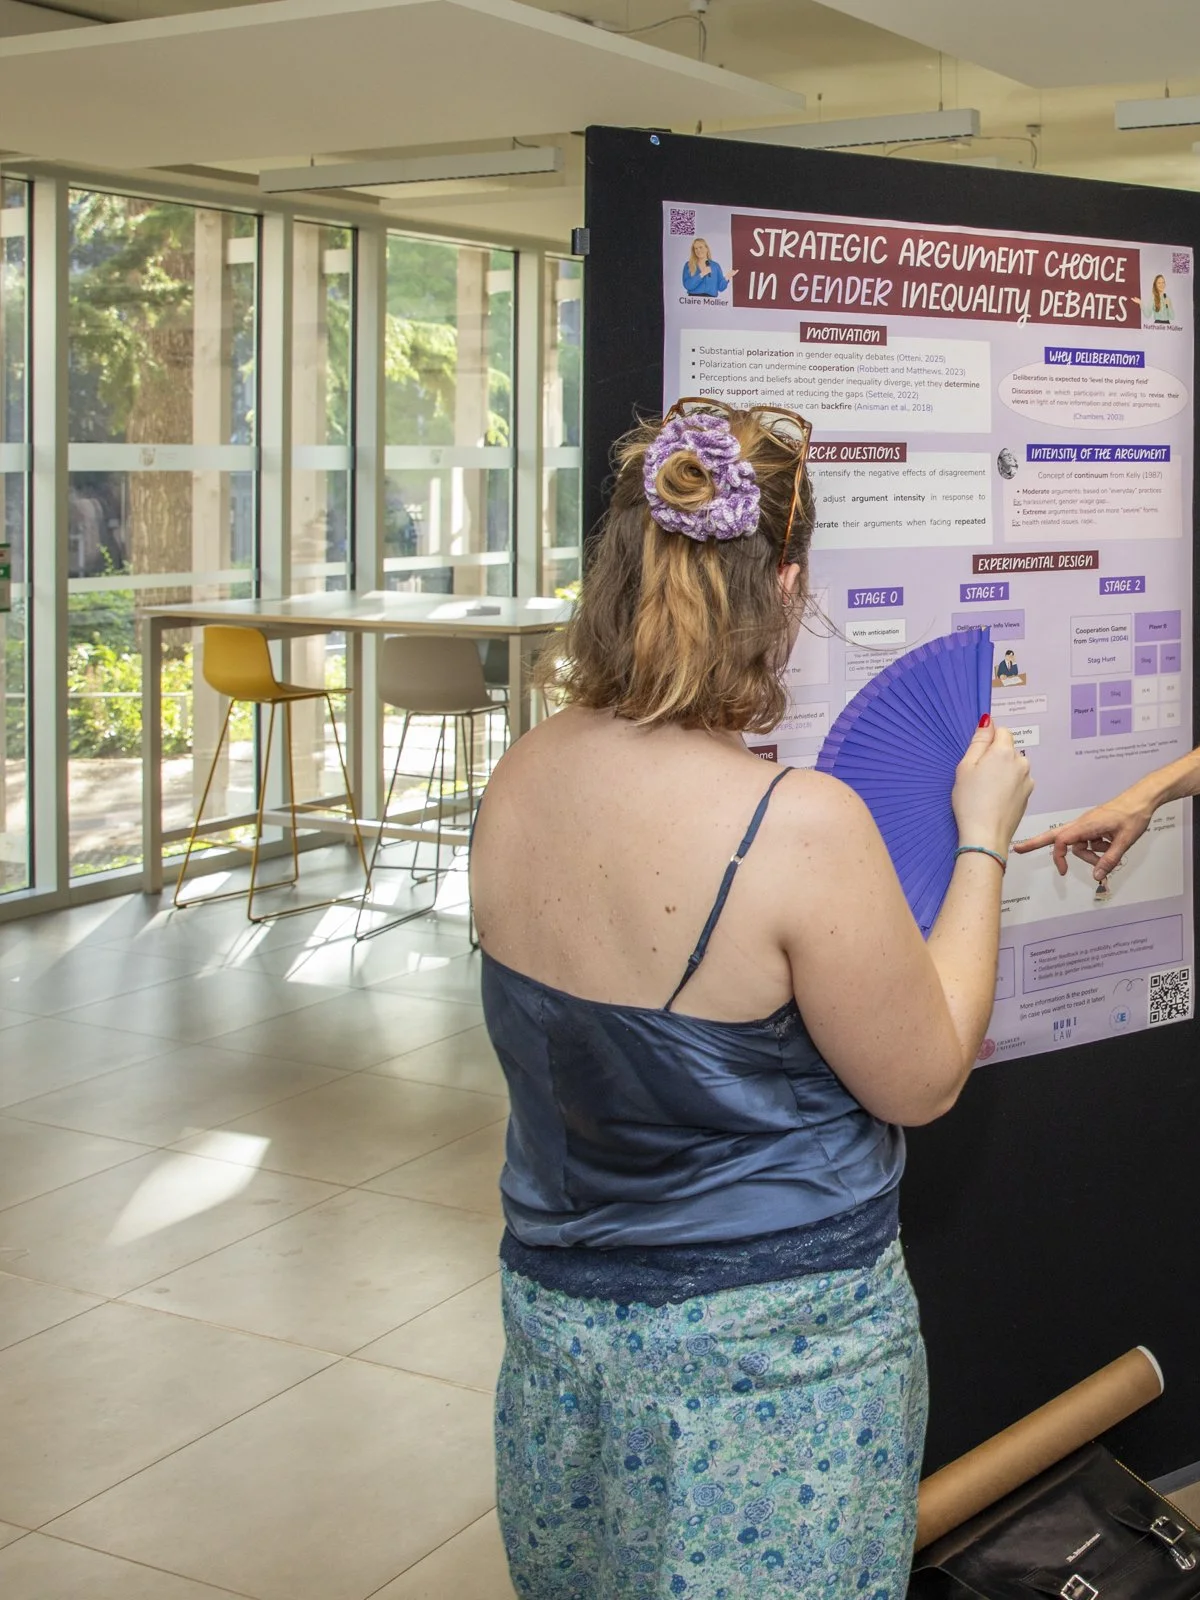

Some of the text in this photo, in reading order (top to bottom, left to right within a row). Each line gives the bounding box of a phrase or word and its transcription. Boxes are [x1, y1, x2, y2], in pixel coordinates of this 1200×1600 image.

[750, 227, 1127, 283] STRATEGIC ARGUMENT CHOICE
[679, 297, 729, 307] Claire Mollier
[749, 271, 1128, 328] IN GENDER INEQUALITY DEBATES
[1143, 323, 1183, 332] Nathalie Müller
[806, 326, 880, 343] MOTIVATION
[699, 346, 745, 356] Substantial
[746, 349, 794, 358] polarization
[805, 352, 832, 360] gender
[834, 352, 863, 361] equality
[865, 353, 894, 361] debates
[925, 355, 946, 363] 2025)
[1049, 350, 1140, 366] WHY DELIBERATION?
[699, 360, 747, 369] Polarization
[765, 363, 806, 371] undermine
[808, 364, 855, 374] cooperation
[857, 365, 889, 374] (Robbett
[890, 366, 905, 374] and
[906, 367, 943, 375] Matthews,
[945, 368, 966, 376] 2023)
[699, 373, 747, 383] Perceptions
[766, 375, 792, 383] beliefs
[794, 376, 816, 384] about
[818, 377, 844, 386] gender
[846, 378, 882, 387] inequality
[884, 378, 912, 388] diverge,
[914, 379, 925, 387] yet
[927, 380, 942, 388] they
[944, 380, 980, 389] determine
[1013, 374, 1047, 382] Deliberation
[1055, 376, 1080, 384] expected
[699, 387, 724, 396] policy
[726, 388, 758, 398] support
[760, 389, 784, 397] aimed
[796, 390, 829, 399] reducing
[831, 390, 843, 398] the
[845, 391, 864, 399] gaps
[897, 391, 918, 400] 2022)
[784, 402, 803, 410] issue
[854, 403, 889, 411] (Anisman
[912, 404, 933, 413] 2018)
[840, 446, 900, 460] QUESTIONS
[1031, 447, 1167, 463] INTENSITY OF THE ARGUMENT
[818, 469, 850, 478] intensify
[853, 469, 866, 477] the
[868, 470, 899, 478] negative
[902, 469, 926, 477] effects
[938, 469, 986, 479] disagreement
[1038, 472, 1064, 480] Concept
[1110, 471, 1125, 479] from
[1126, 471, 1140, 480] Kelly
[1142, 471, 1163, 480] (1987)
[823, 495, 846, 504] adjust
[851, 494, 888, 504] argument
[893, 494, 925, 503] intensity
[930, 493, 937, 501] in
[942, 494, 973, 502] response
[842, 517, 986, 529] their arguments when facing repeated
[978, 554, 1093, 572] EXPERIMENTAL DESIGN
[1104, 580, 1141, 592] STAGE 2
[853, 591, 898, 605] STAGE 0
[965, 586, 1004, 600] STAGE 1
[1076, 626, 1110, 635] Cooperation
[1088, 636, 1110, 644] Skyrms
[1110, 635, 1129, 643] (2004)
[1034, 995, 1065, 1006] information
[1081, 988, 1098, 997] poster
[1041, 1008, 1051, 1017] you
[1052, 1004, 1066, 1012] want
[1073, 1000, 1085, 1008] read
[1053, 1017, 1077, 1030] MUNI
[1053, 1030, 1072, 1042] LAW
[996, 1041, 1026, 1051] UNIVERSITY
